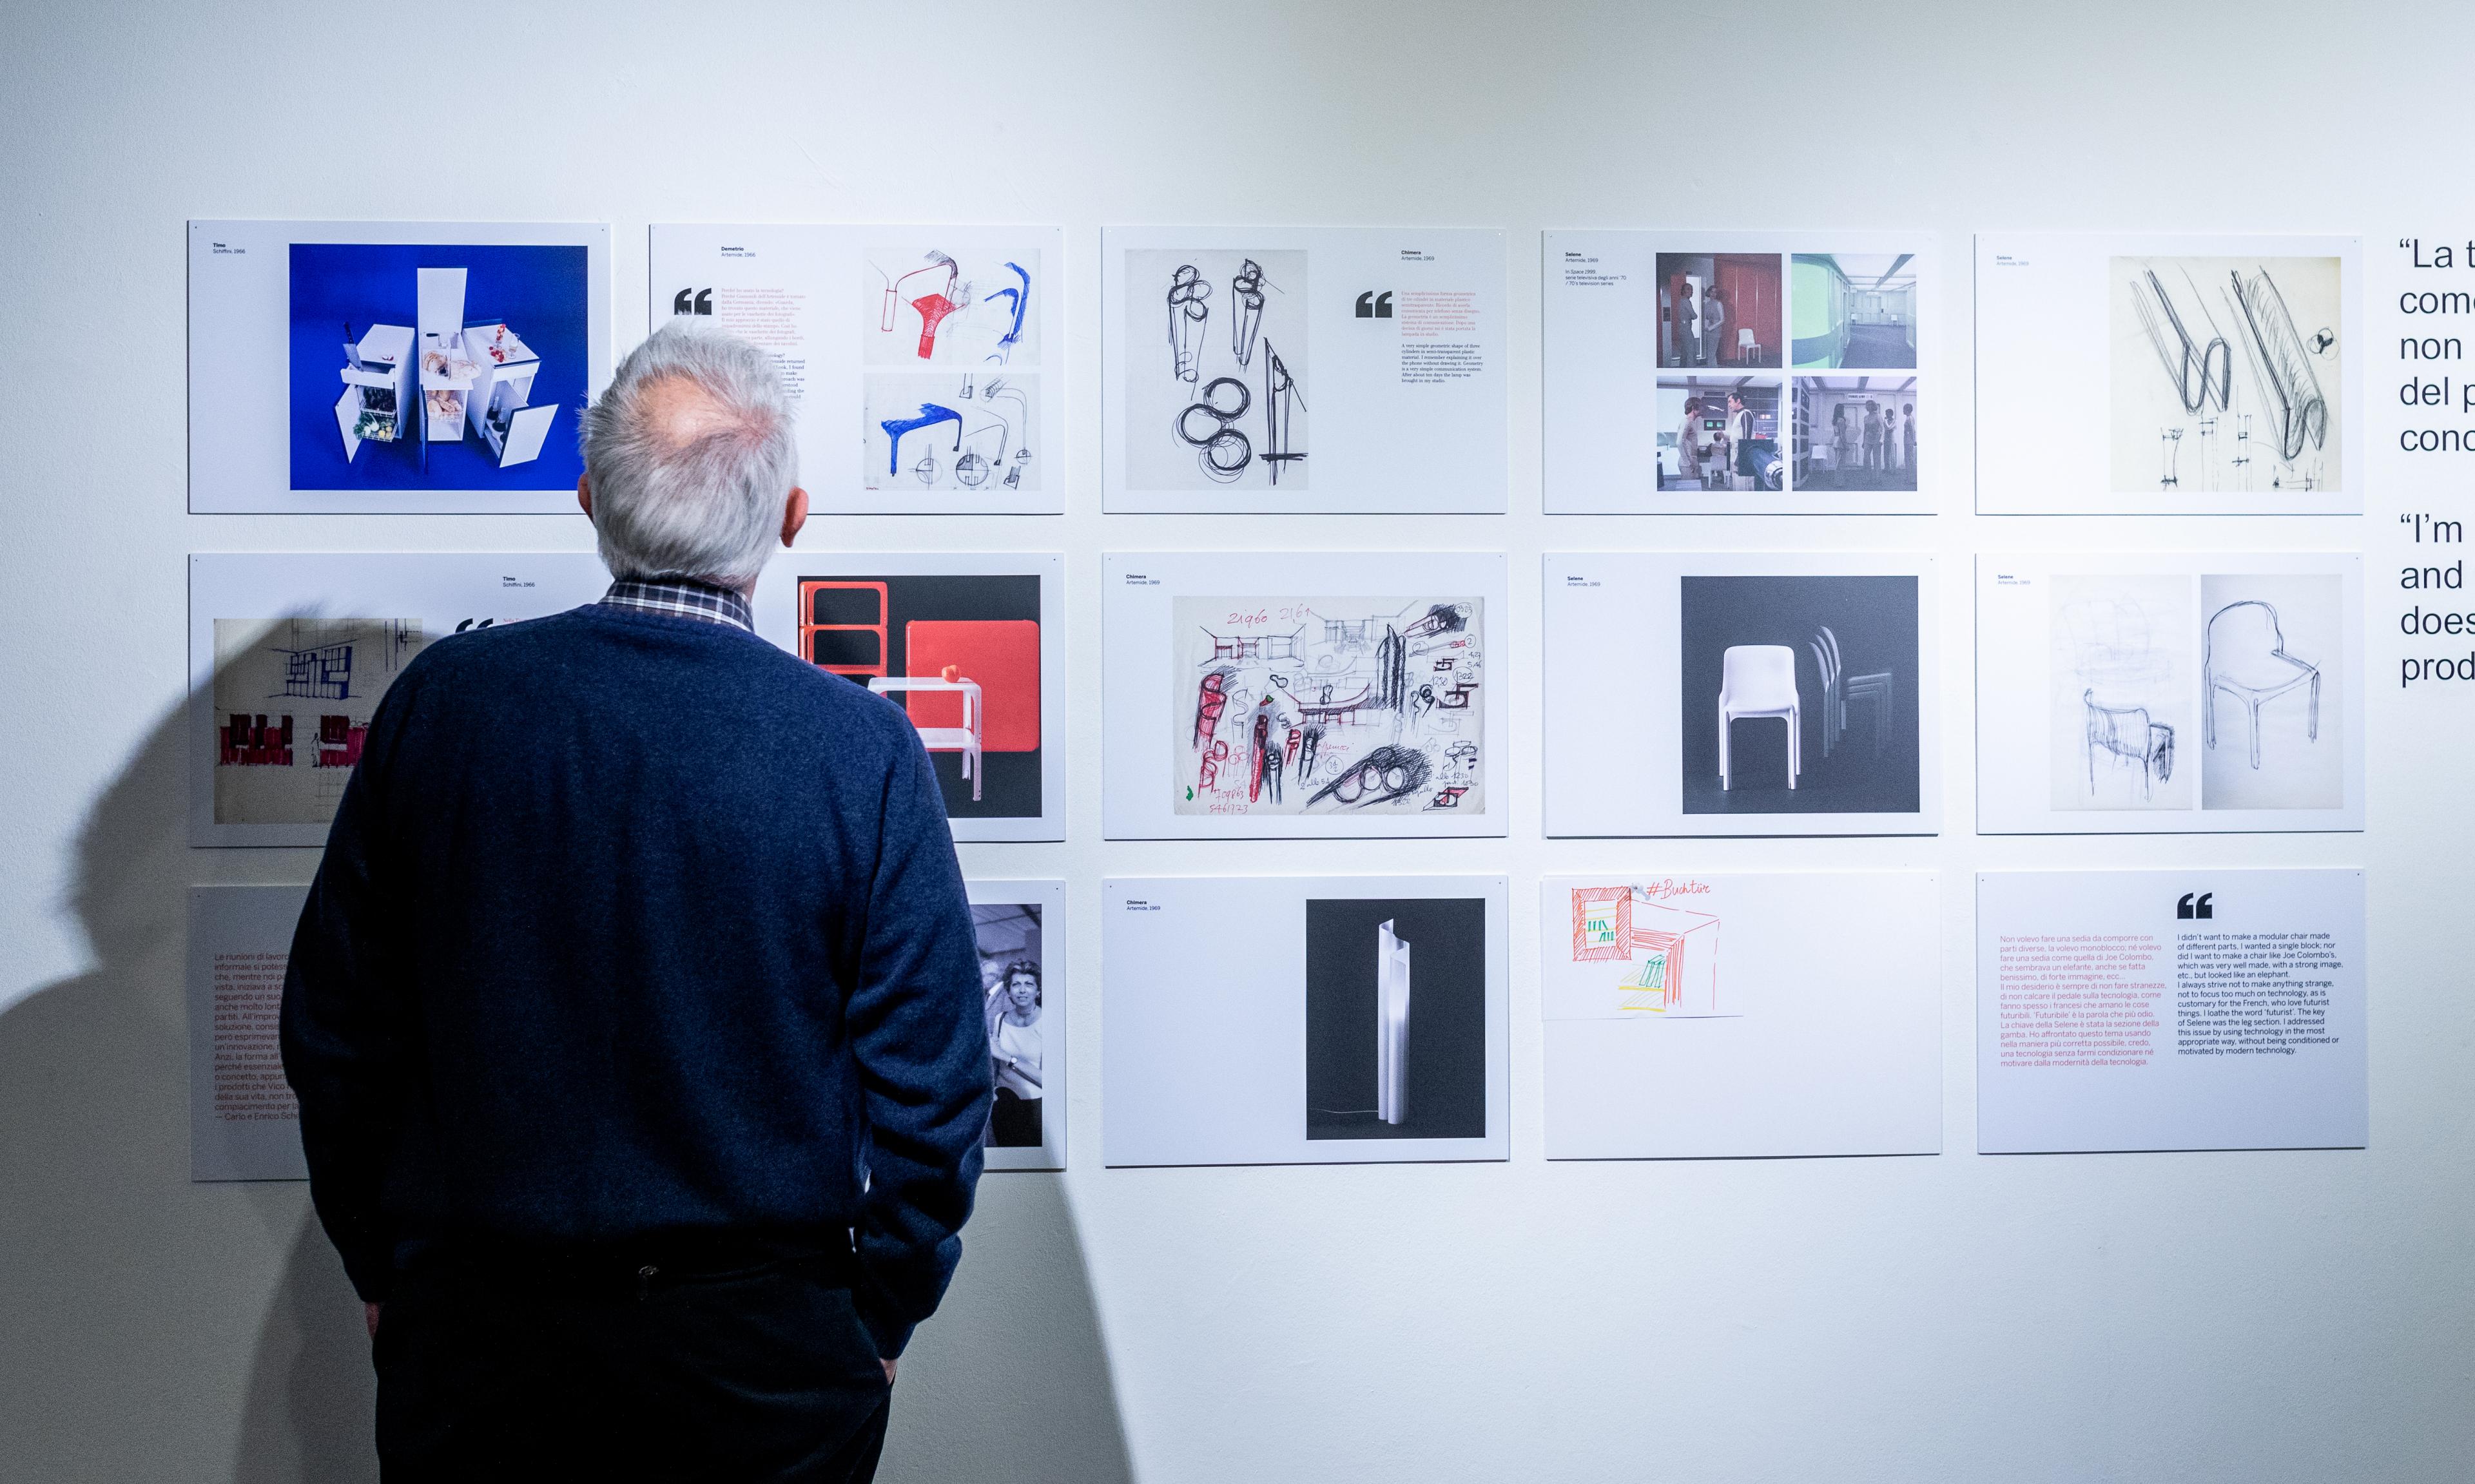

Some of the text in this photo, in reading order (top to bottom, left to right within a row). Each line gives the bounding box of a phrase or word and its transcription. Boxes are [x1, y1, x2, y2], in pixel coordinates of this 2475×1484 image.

[2400, 238, 2453, 268] “La
[2400, 292, 2475, 314] com
[2401, 338, 2462, 360] non
[2400, 376, 2449, 406] del
[2401, 560, 2462, 589] and
[2402, 651, 2475, 688] prod
[2000, 945, 2017, 954] parti
[2103, 936, 2139, 944] comporre
[2278, 941, 2299, 951] single
[2295, 961, 2318, 970] strong
